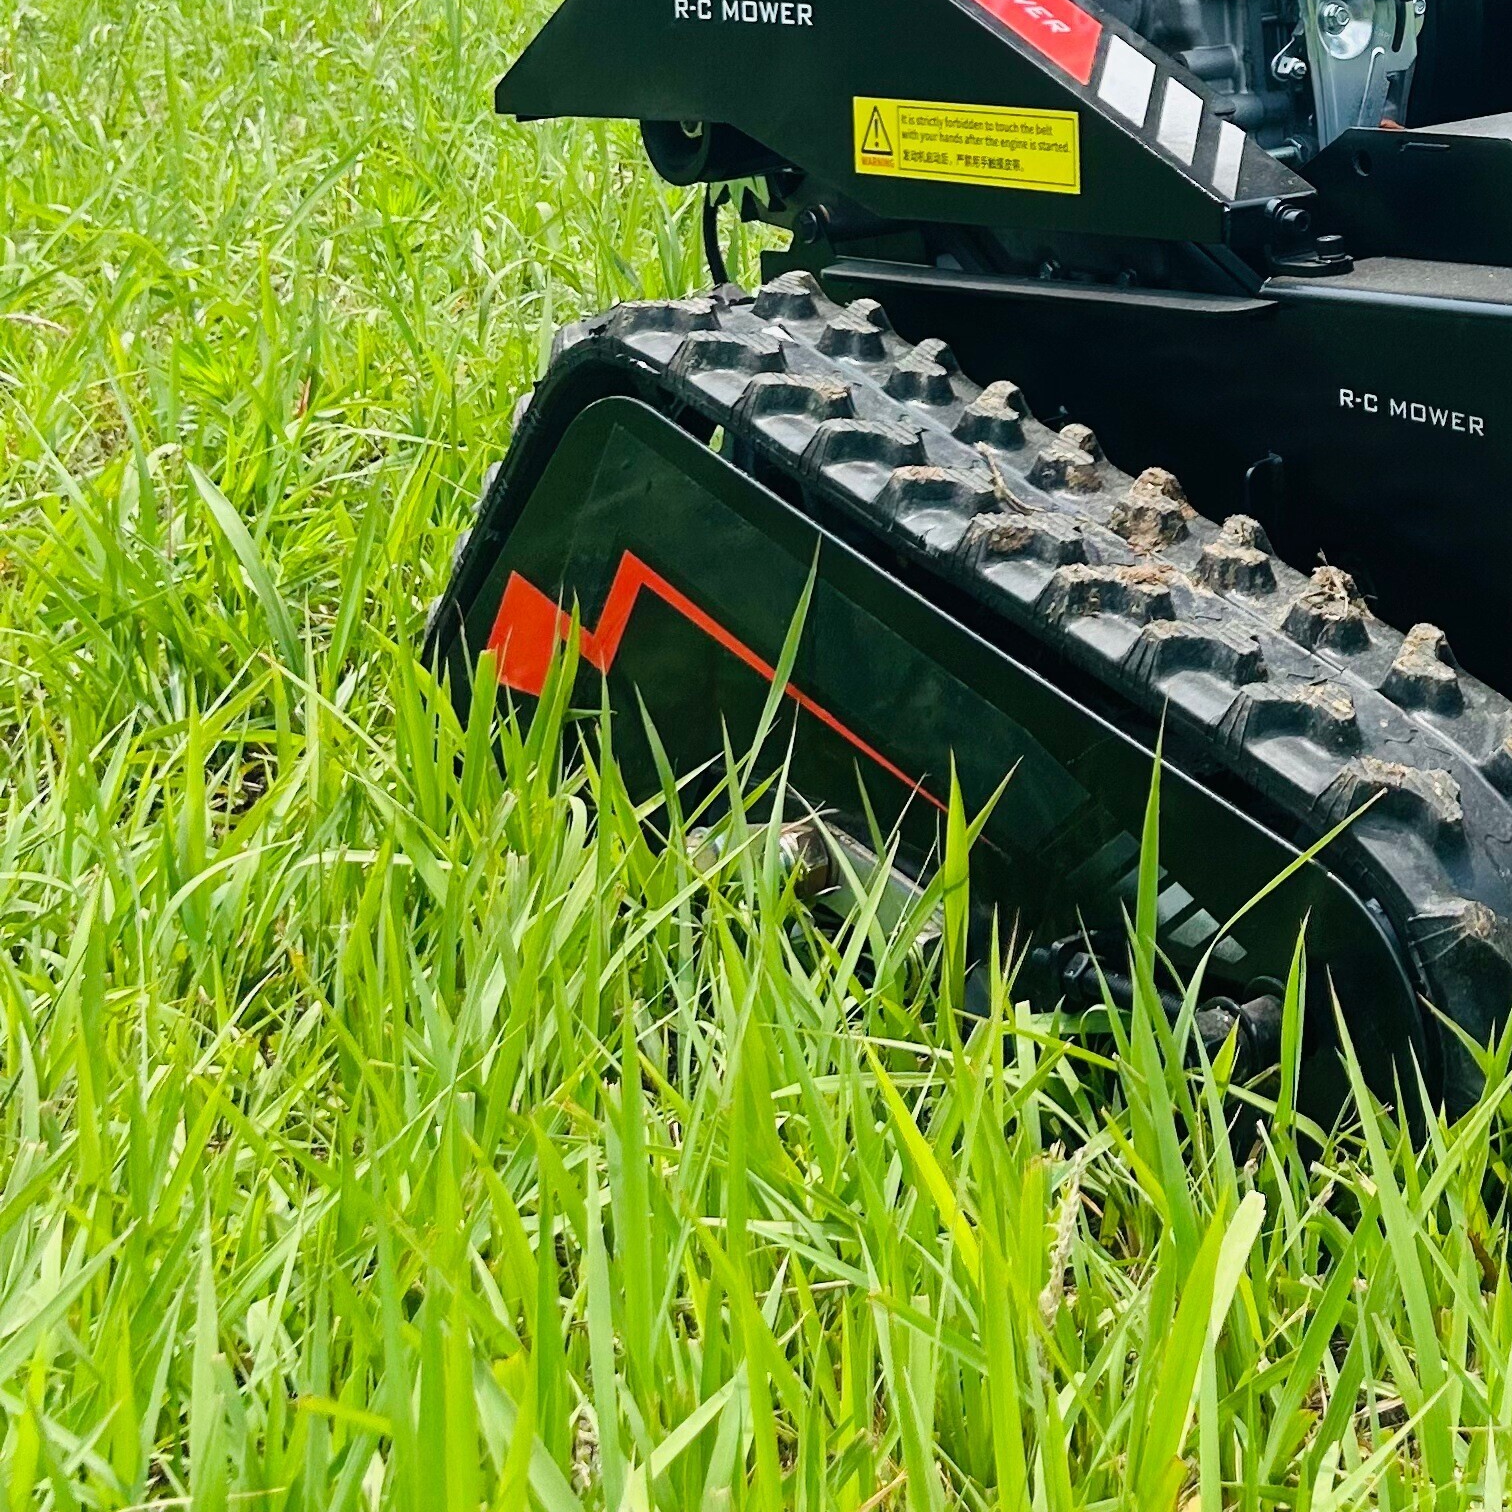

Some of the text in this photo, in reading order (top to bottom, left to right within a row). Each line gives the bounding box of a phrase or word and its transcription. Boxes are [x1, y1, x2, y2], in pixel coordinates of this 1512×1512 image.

[721, 0, 813, 26] MOWER
[916, 116, 943, 129] strictly
[944, 116, 983, 129] forbidden
[985, 120, 994, 131] to
[995, 121, 1018, 133] touch
[1020, 122, 1034, 133] the
[919, 132, 938, 143] your
[939, 131, 963, 144] hands
[964, 133, 983, 146] after
[985, 135, 999, 147] the
[1001, 138, 1028, 151] engine
[1339, 388, 1485, 437] R-C MOWER
